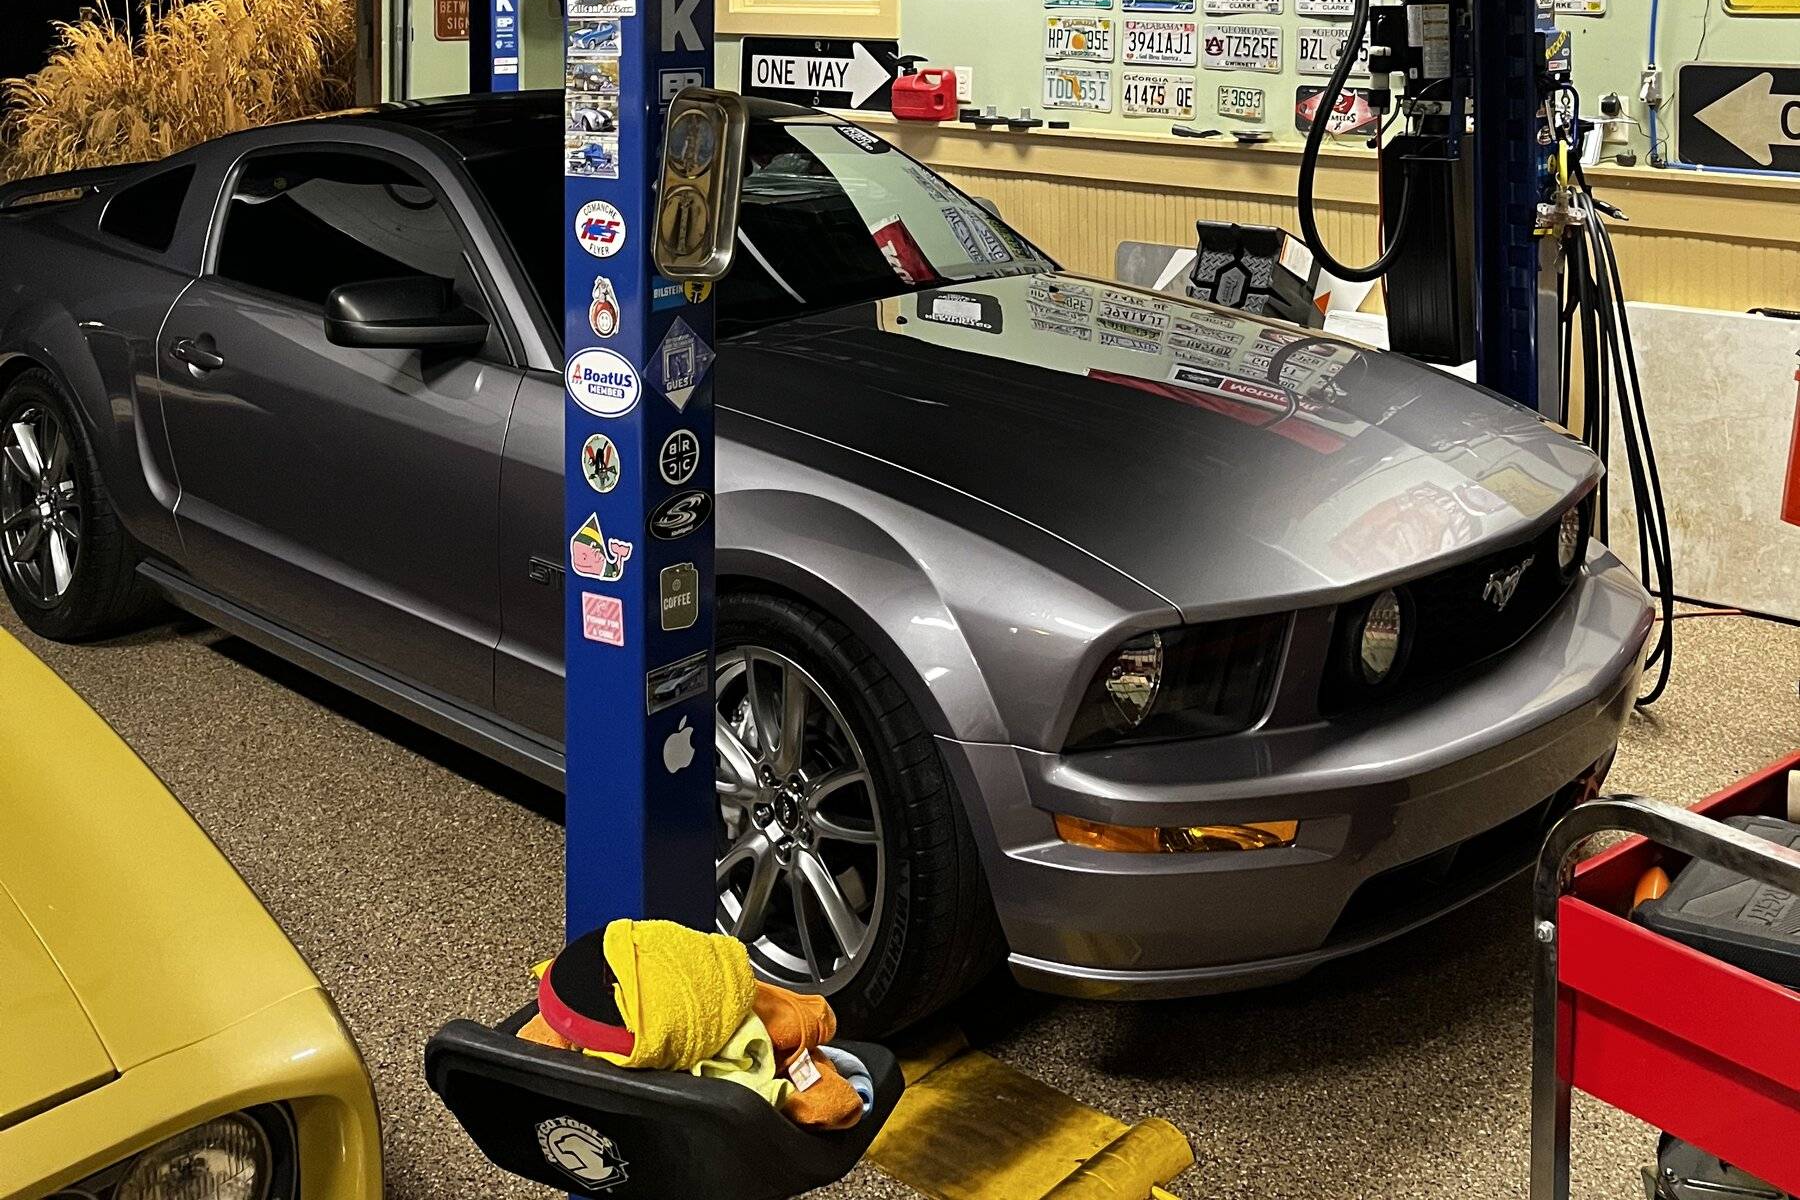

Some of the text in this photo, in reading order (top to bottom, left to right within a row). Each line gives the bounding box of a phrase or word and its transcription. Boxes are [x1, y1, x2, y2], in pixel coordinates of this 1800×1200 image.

[439, 0, 470, 15] BETW
[1141, 21, 1180, 31] ALABAMA
[1221, 25, 1265, 35] GEORGIA
[1048, 27, 1071, 49] HP7
[1128, 31, 1192, 55] 3941AJ1
[1225, 35, 1279, 59] TZ525E
[757, 58, 850, 89] ONE WAY
[1123, 74, 1169, 83] GEORGIA
[1124, 84, 1193, 109] 41475 QE
[1230, 88, 1262, 109] 3693
[582, 202, 618, 220] COMANCHE
[589, 242, 611, 256] FLYER
[590, 385, 624, 399] MEMBER
[666, 374, 694, 392] GUEST
[663, 591, 692, 611] COFFEE
